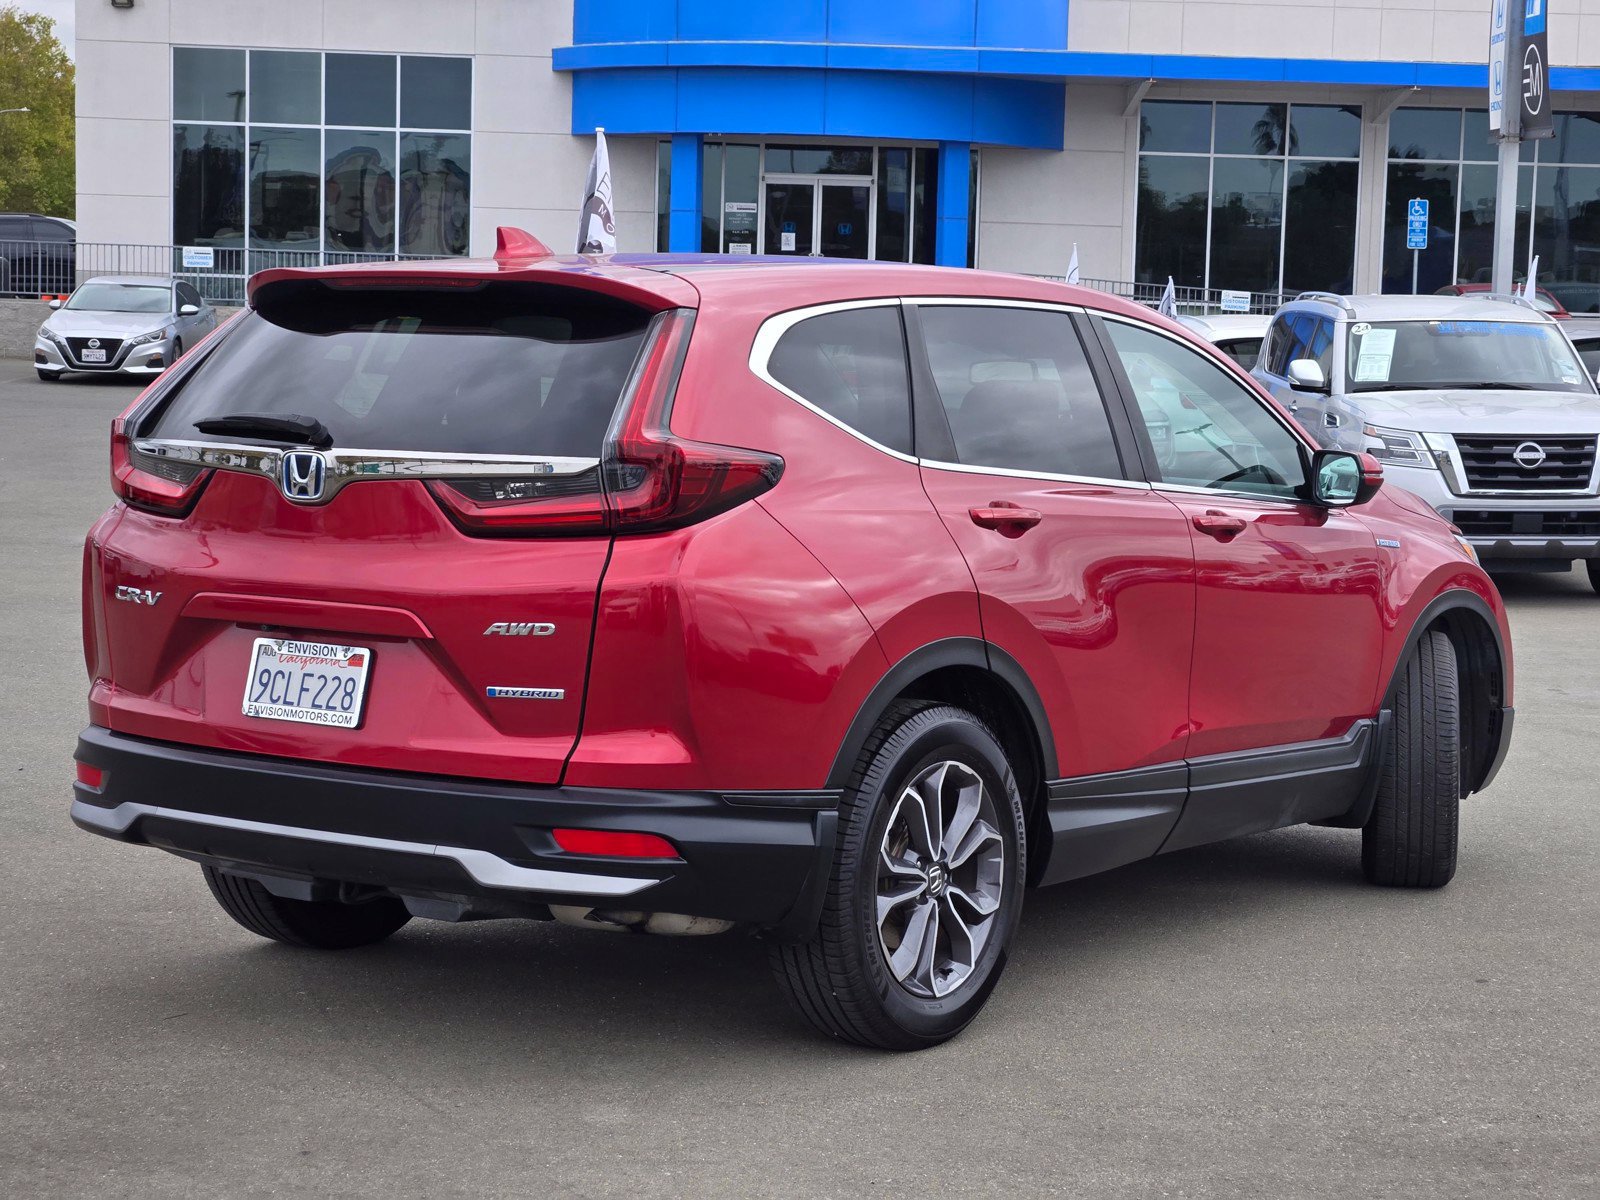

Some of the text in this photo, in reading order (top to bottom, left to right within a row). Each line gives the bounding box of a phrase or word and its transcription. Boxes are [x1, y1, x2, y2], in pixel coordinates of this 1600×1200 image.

[115, 585, 163, 606] CR-V
[483, 622, 556, 636] AWD
[261, 646, 277, 657] AUG
[287, 642, 338, 658] ENVISION
[253, 668, 357, 711] 9CLF228
[497, 689, 559, 698] HYBRID
[247, 704, 353, 725] ENVISIONMOTORS.COM
